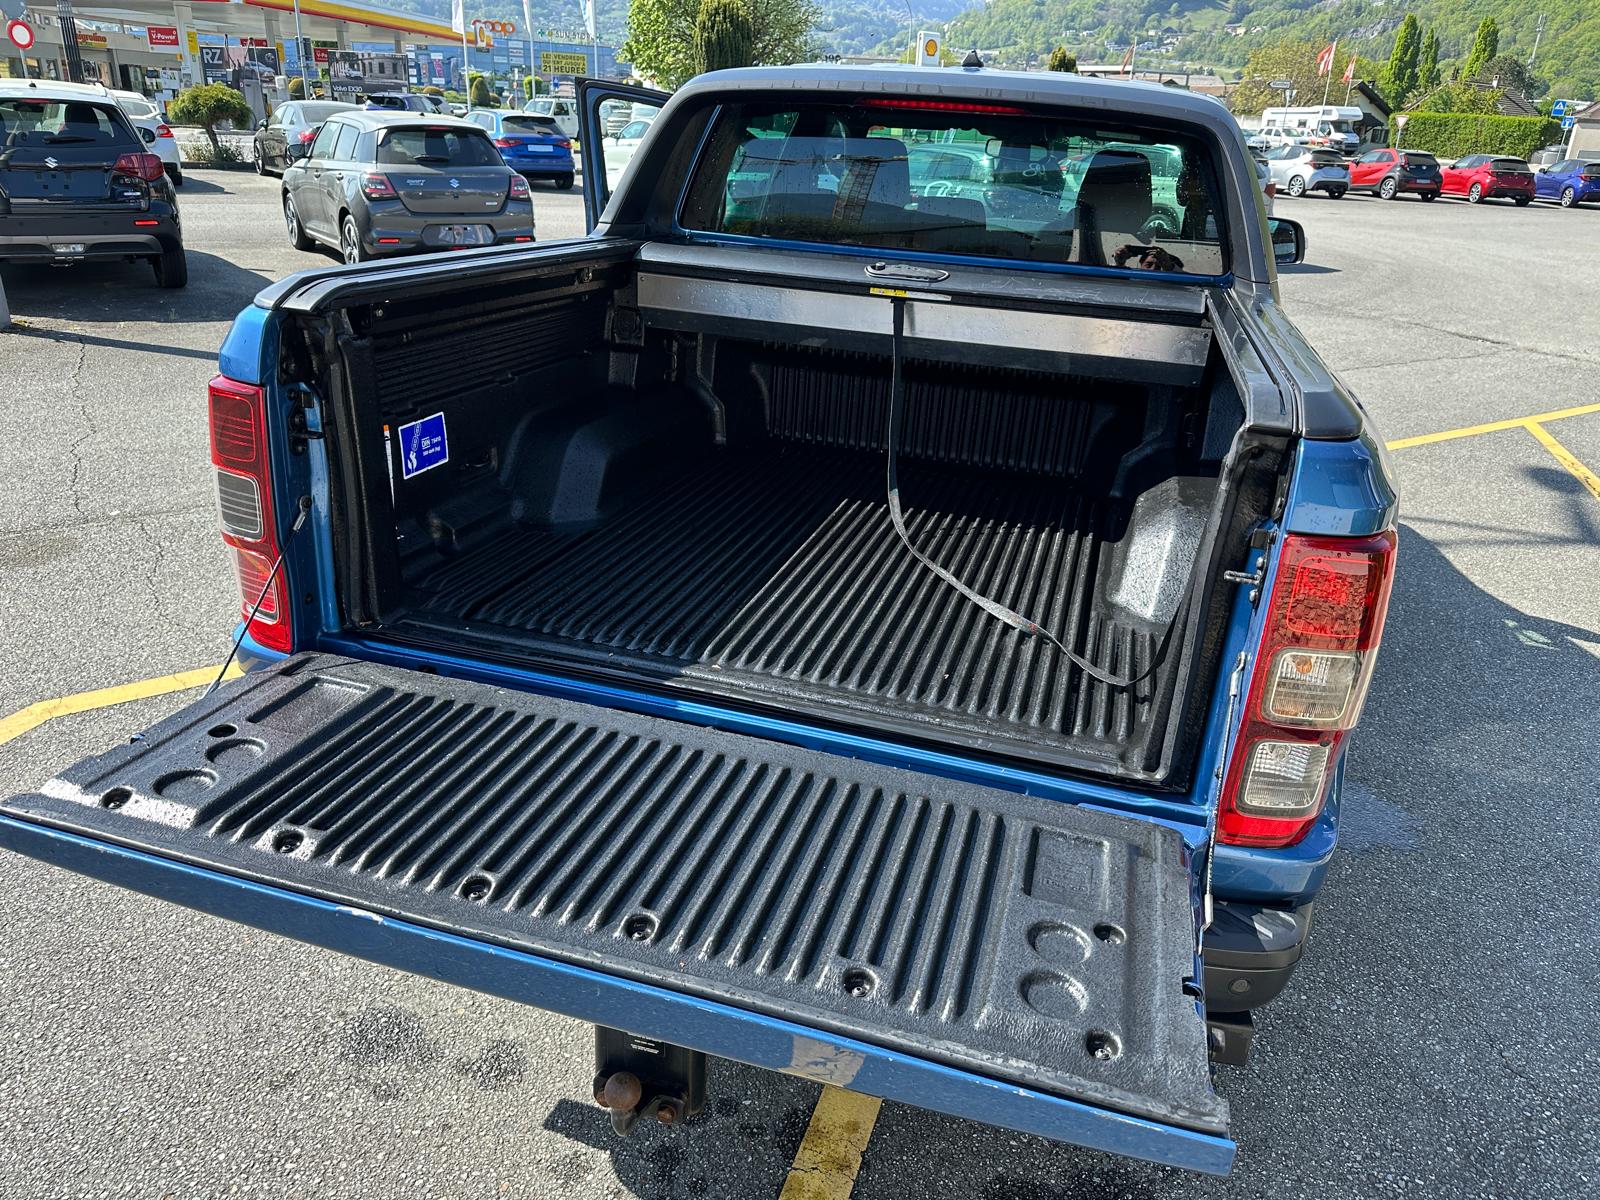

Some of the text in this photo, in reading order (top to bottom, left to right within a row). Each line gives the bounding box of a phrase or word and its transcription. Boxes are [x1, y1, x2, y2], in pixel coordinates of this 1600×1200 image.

[77, 31, 107, 42] igrolino
[203, 49, 222, 63] RZ
[542, 65, 586, 75] 21 HEURES
